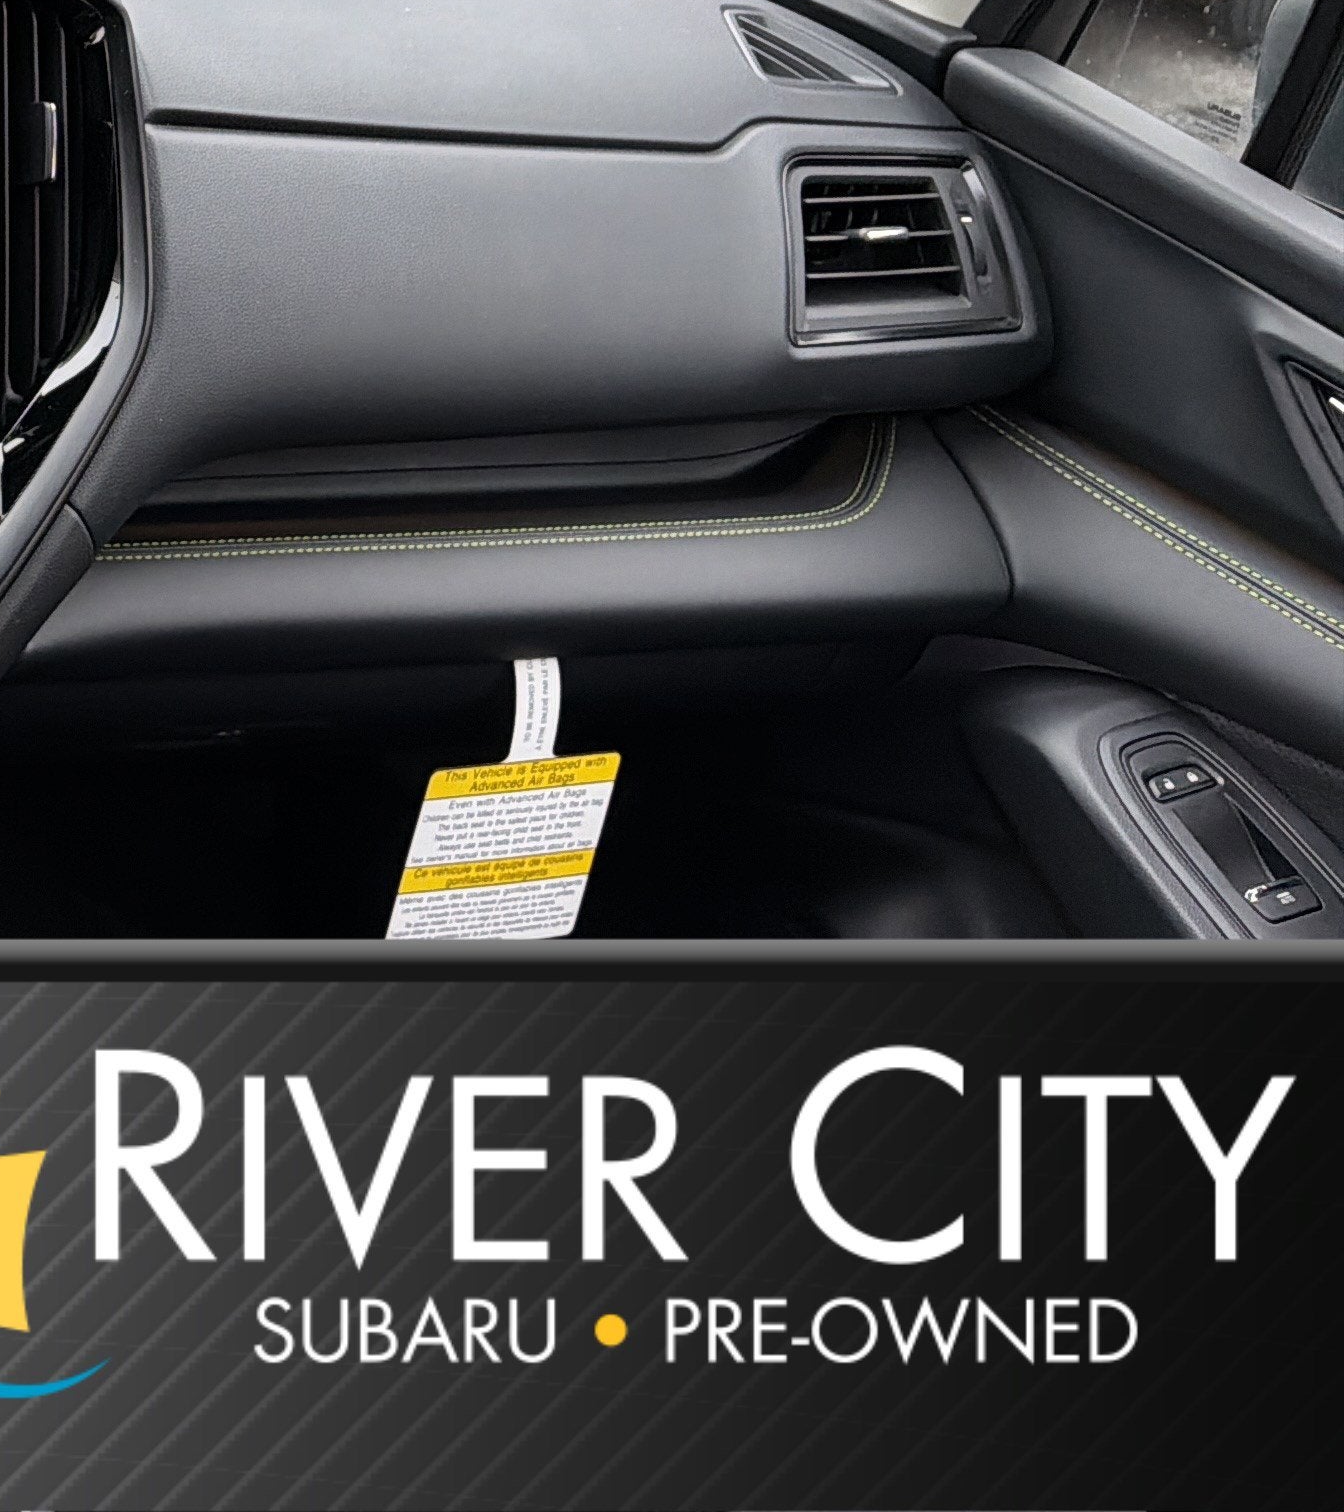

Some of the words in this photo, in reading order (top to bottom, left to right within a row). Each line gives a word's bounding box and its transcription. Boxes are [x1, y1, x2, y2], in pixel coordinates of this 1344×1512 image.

[445, 770, 468, 782] This
[473, 766, 513, 780] Vehicle
[516, 765, 526, 775] is
[530, 759, 582, 774] Equipped
[586, 756, 607, 768] with
[469, 777, 525, 792] Advanced
[527, 775, 544, 786] Air
[548, 773, 575, 786] Bags
[448, 800, 473, 810] Even
[498, 792, 545, 804] Advanced
[547, 791, 561, 800] Air
[563, 788, 587, 798] Bags
